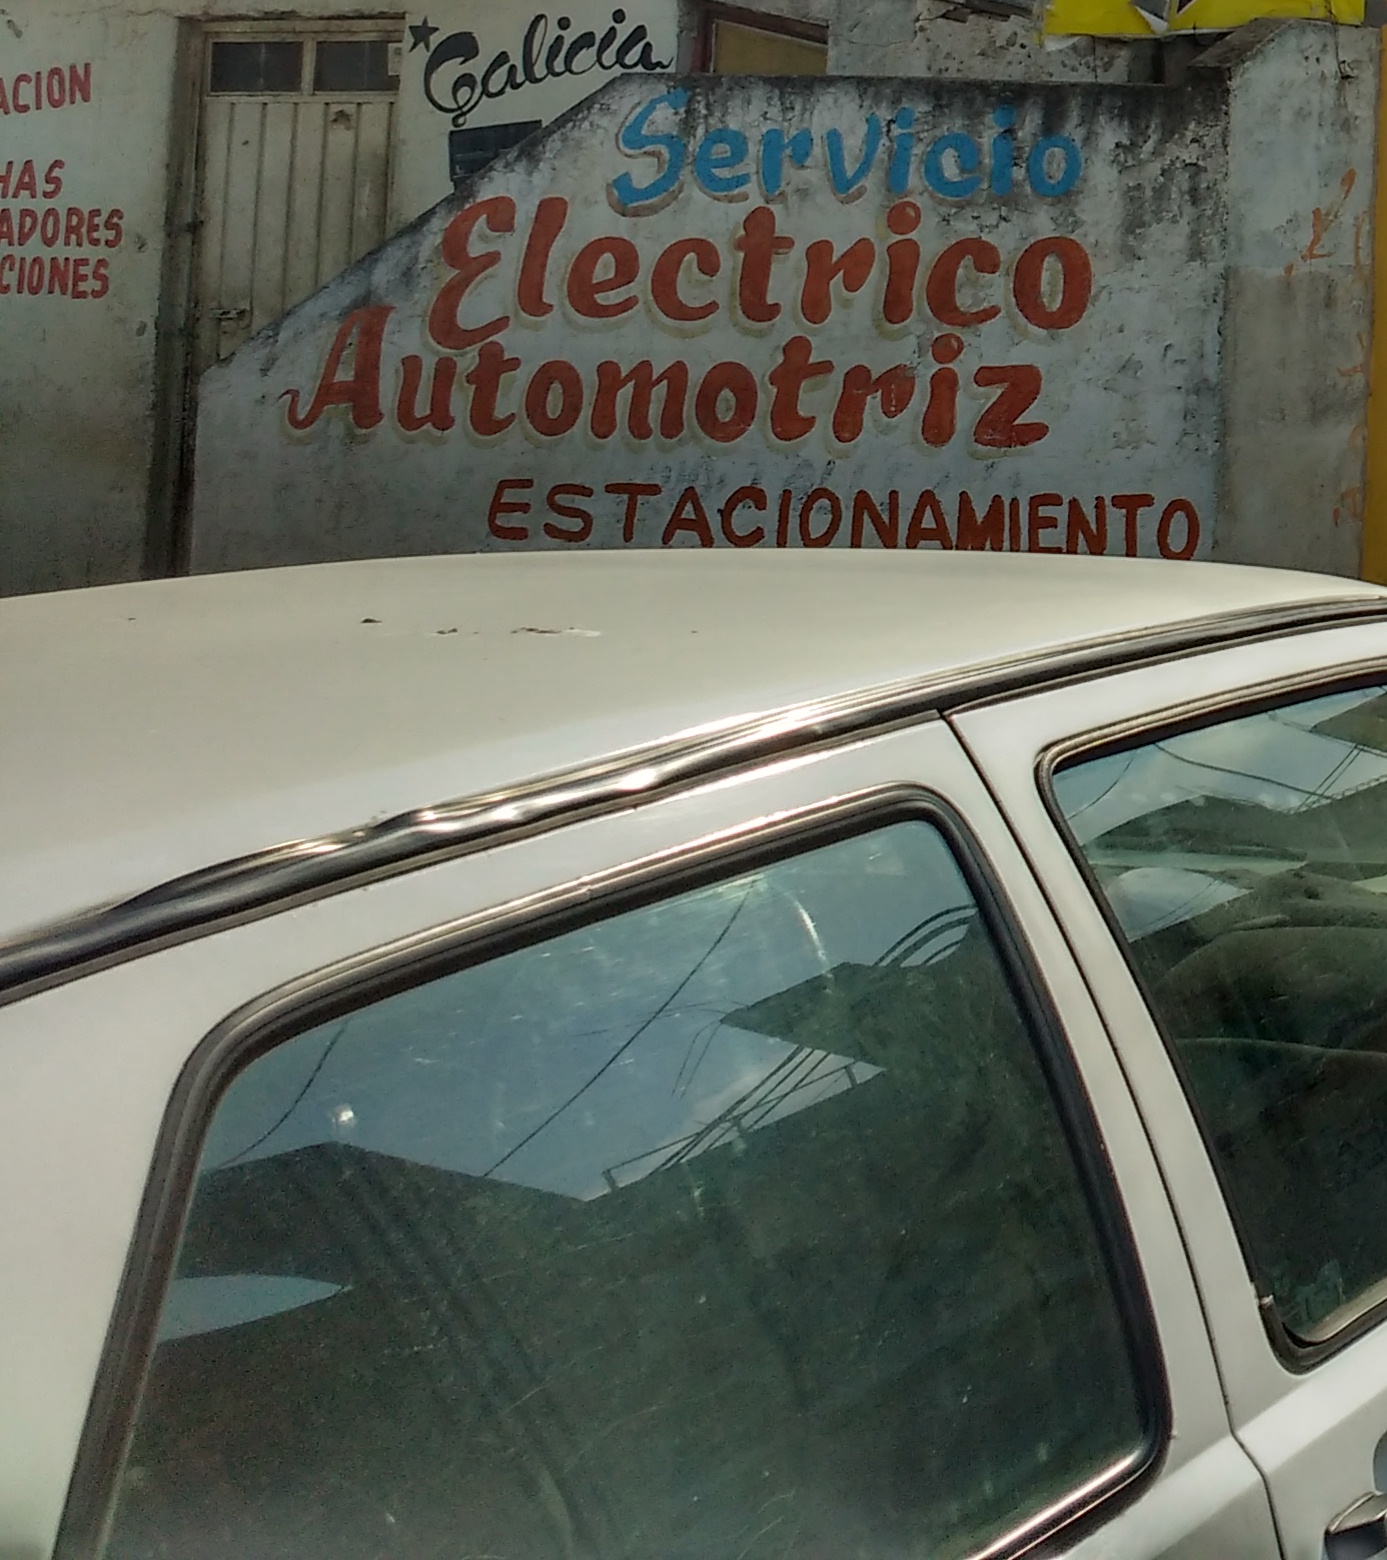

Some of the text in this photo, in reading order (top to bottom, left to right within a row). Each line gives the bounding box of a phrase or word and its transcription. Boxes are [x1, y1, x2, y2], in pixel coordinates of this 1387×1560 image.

[423, 9, 672, 129] Galicia
[609, 87, 1083, 212] Servicio
[427, 195, 1095, 351] Electrico
[277, 305, 1051, 450] Automotriz
[487, 477, 1202, 561] ESTACIONAMIENTO
